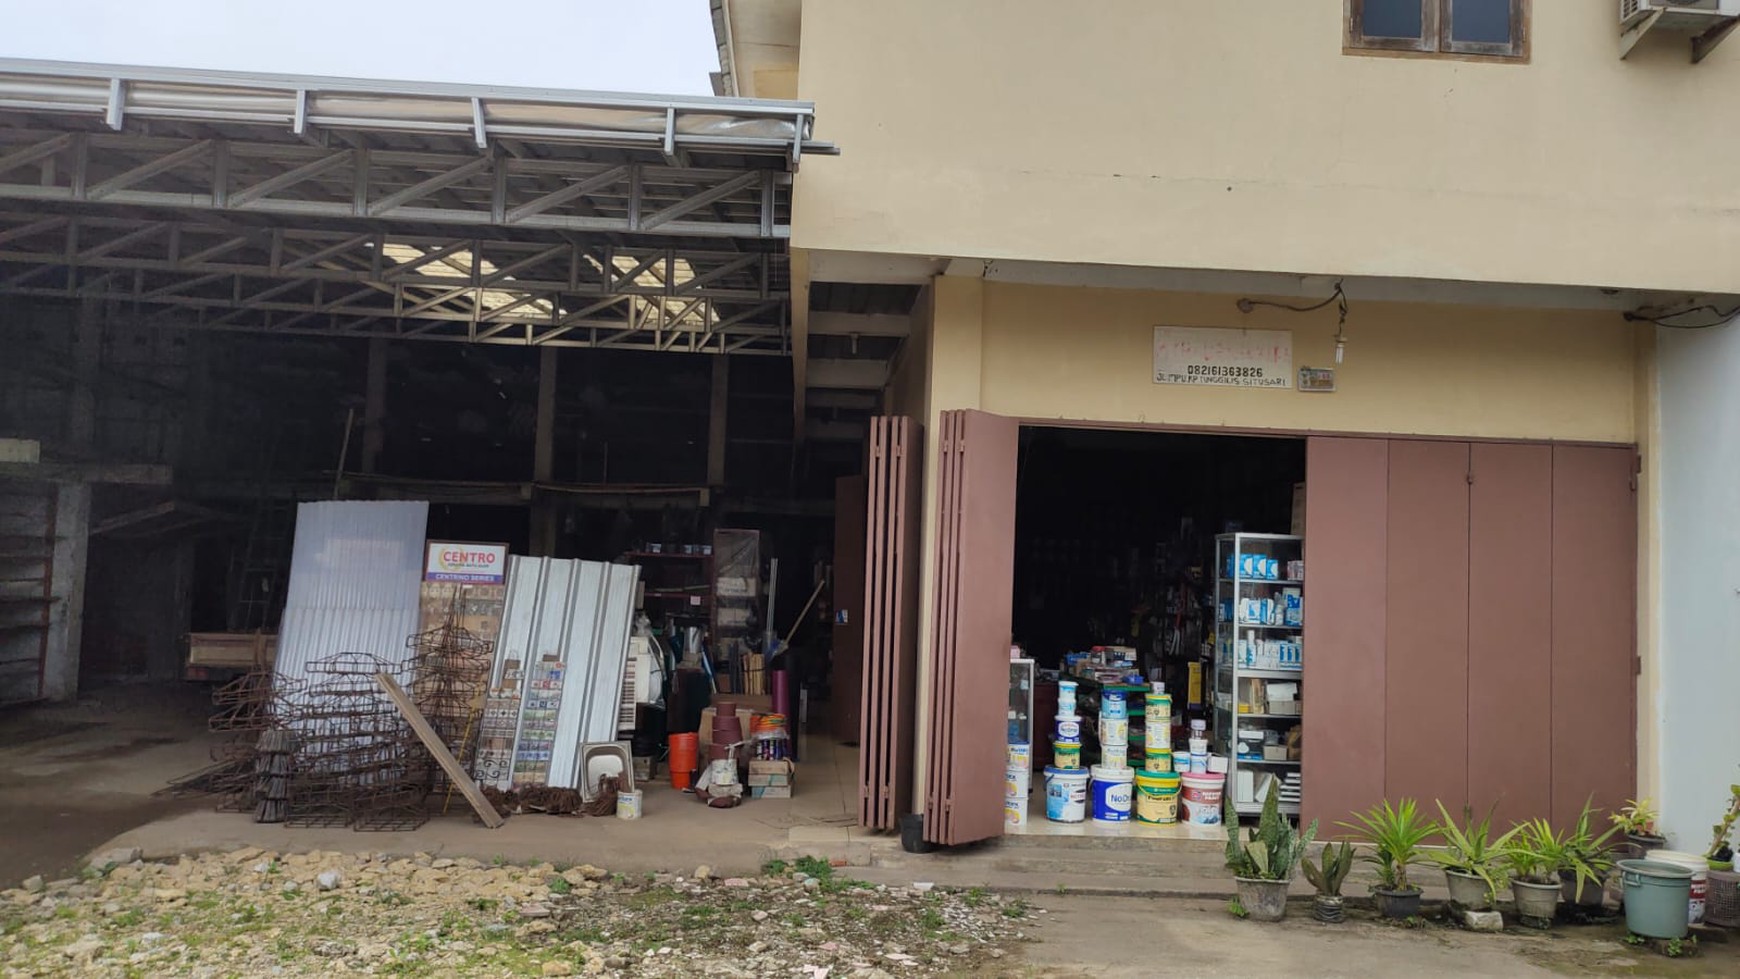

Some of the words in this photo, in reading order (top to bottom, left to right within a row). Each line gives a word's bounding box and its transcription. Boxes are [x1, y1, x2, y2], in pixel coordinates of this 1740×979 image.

[1187, 365, 1263, 377] 082161363826
[1243, 377, 1286, 387] SITUSARI
[444, 552, 495, 563] CENTRO
